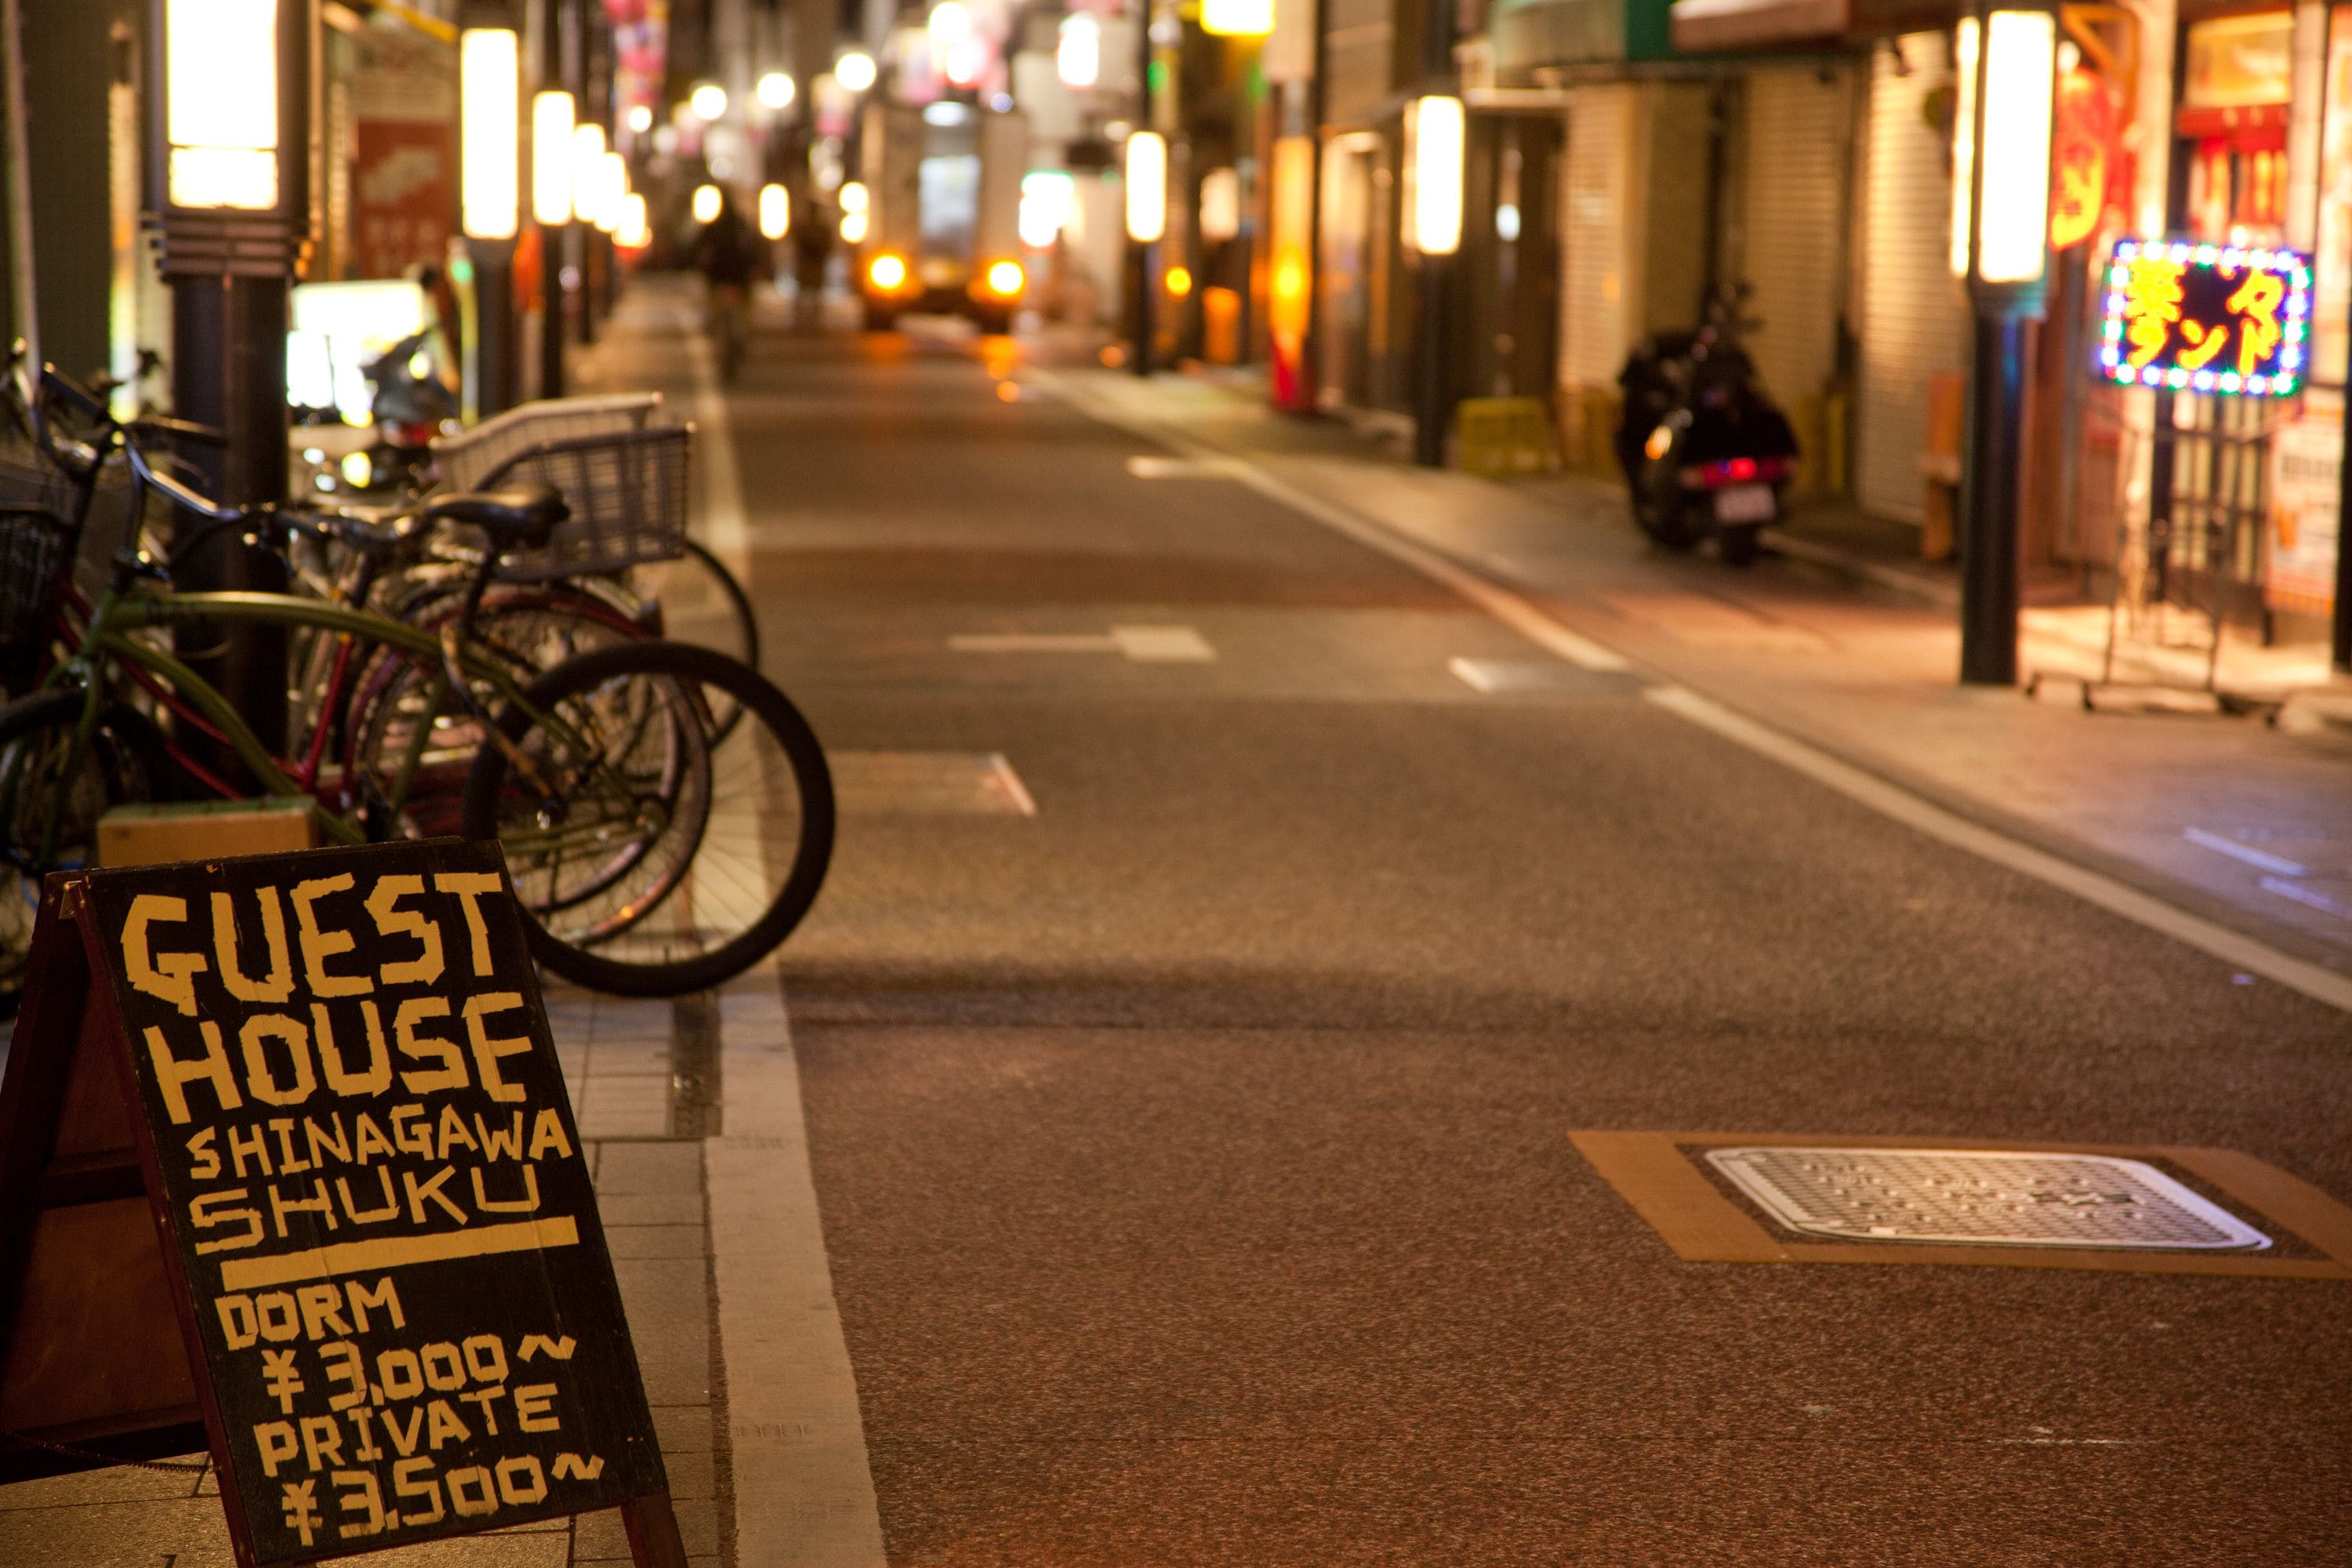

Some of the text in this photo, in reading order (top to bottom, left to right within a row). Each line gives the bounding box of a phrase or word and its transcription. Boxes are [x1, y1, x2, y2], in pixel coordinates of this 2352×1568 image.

[122, 873, 502, 1016] GUEST
[143, 992, 532, 1123] HOUSE
[187, 1104, 572, 1178] SHINAGAWA
[190, 1164, 539, 1254] SHUKU
[215, 1276, 405, 1350] DORM
[254, 1384, 559, 1476] PRIVATE
